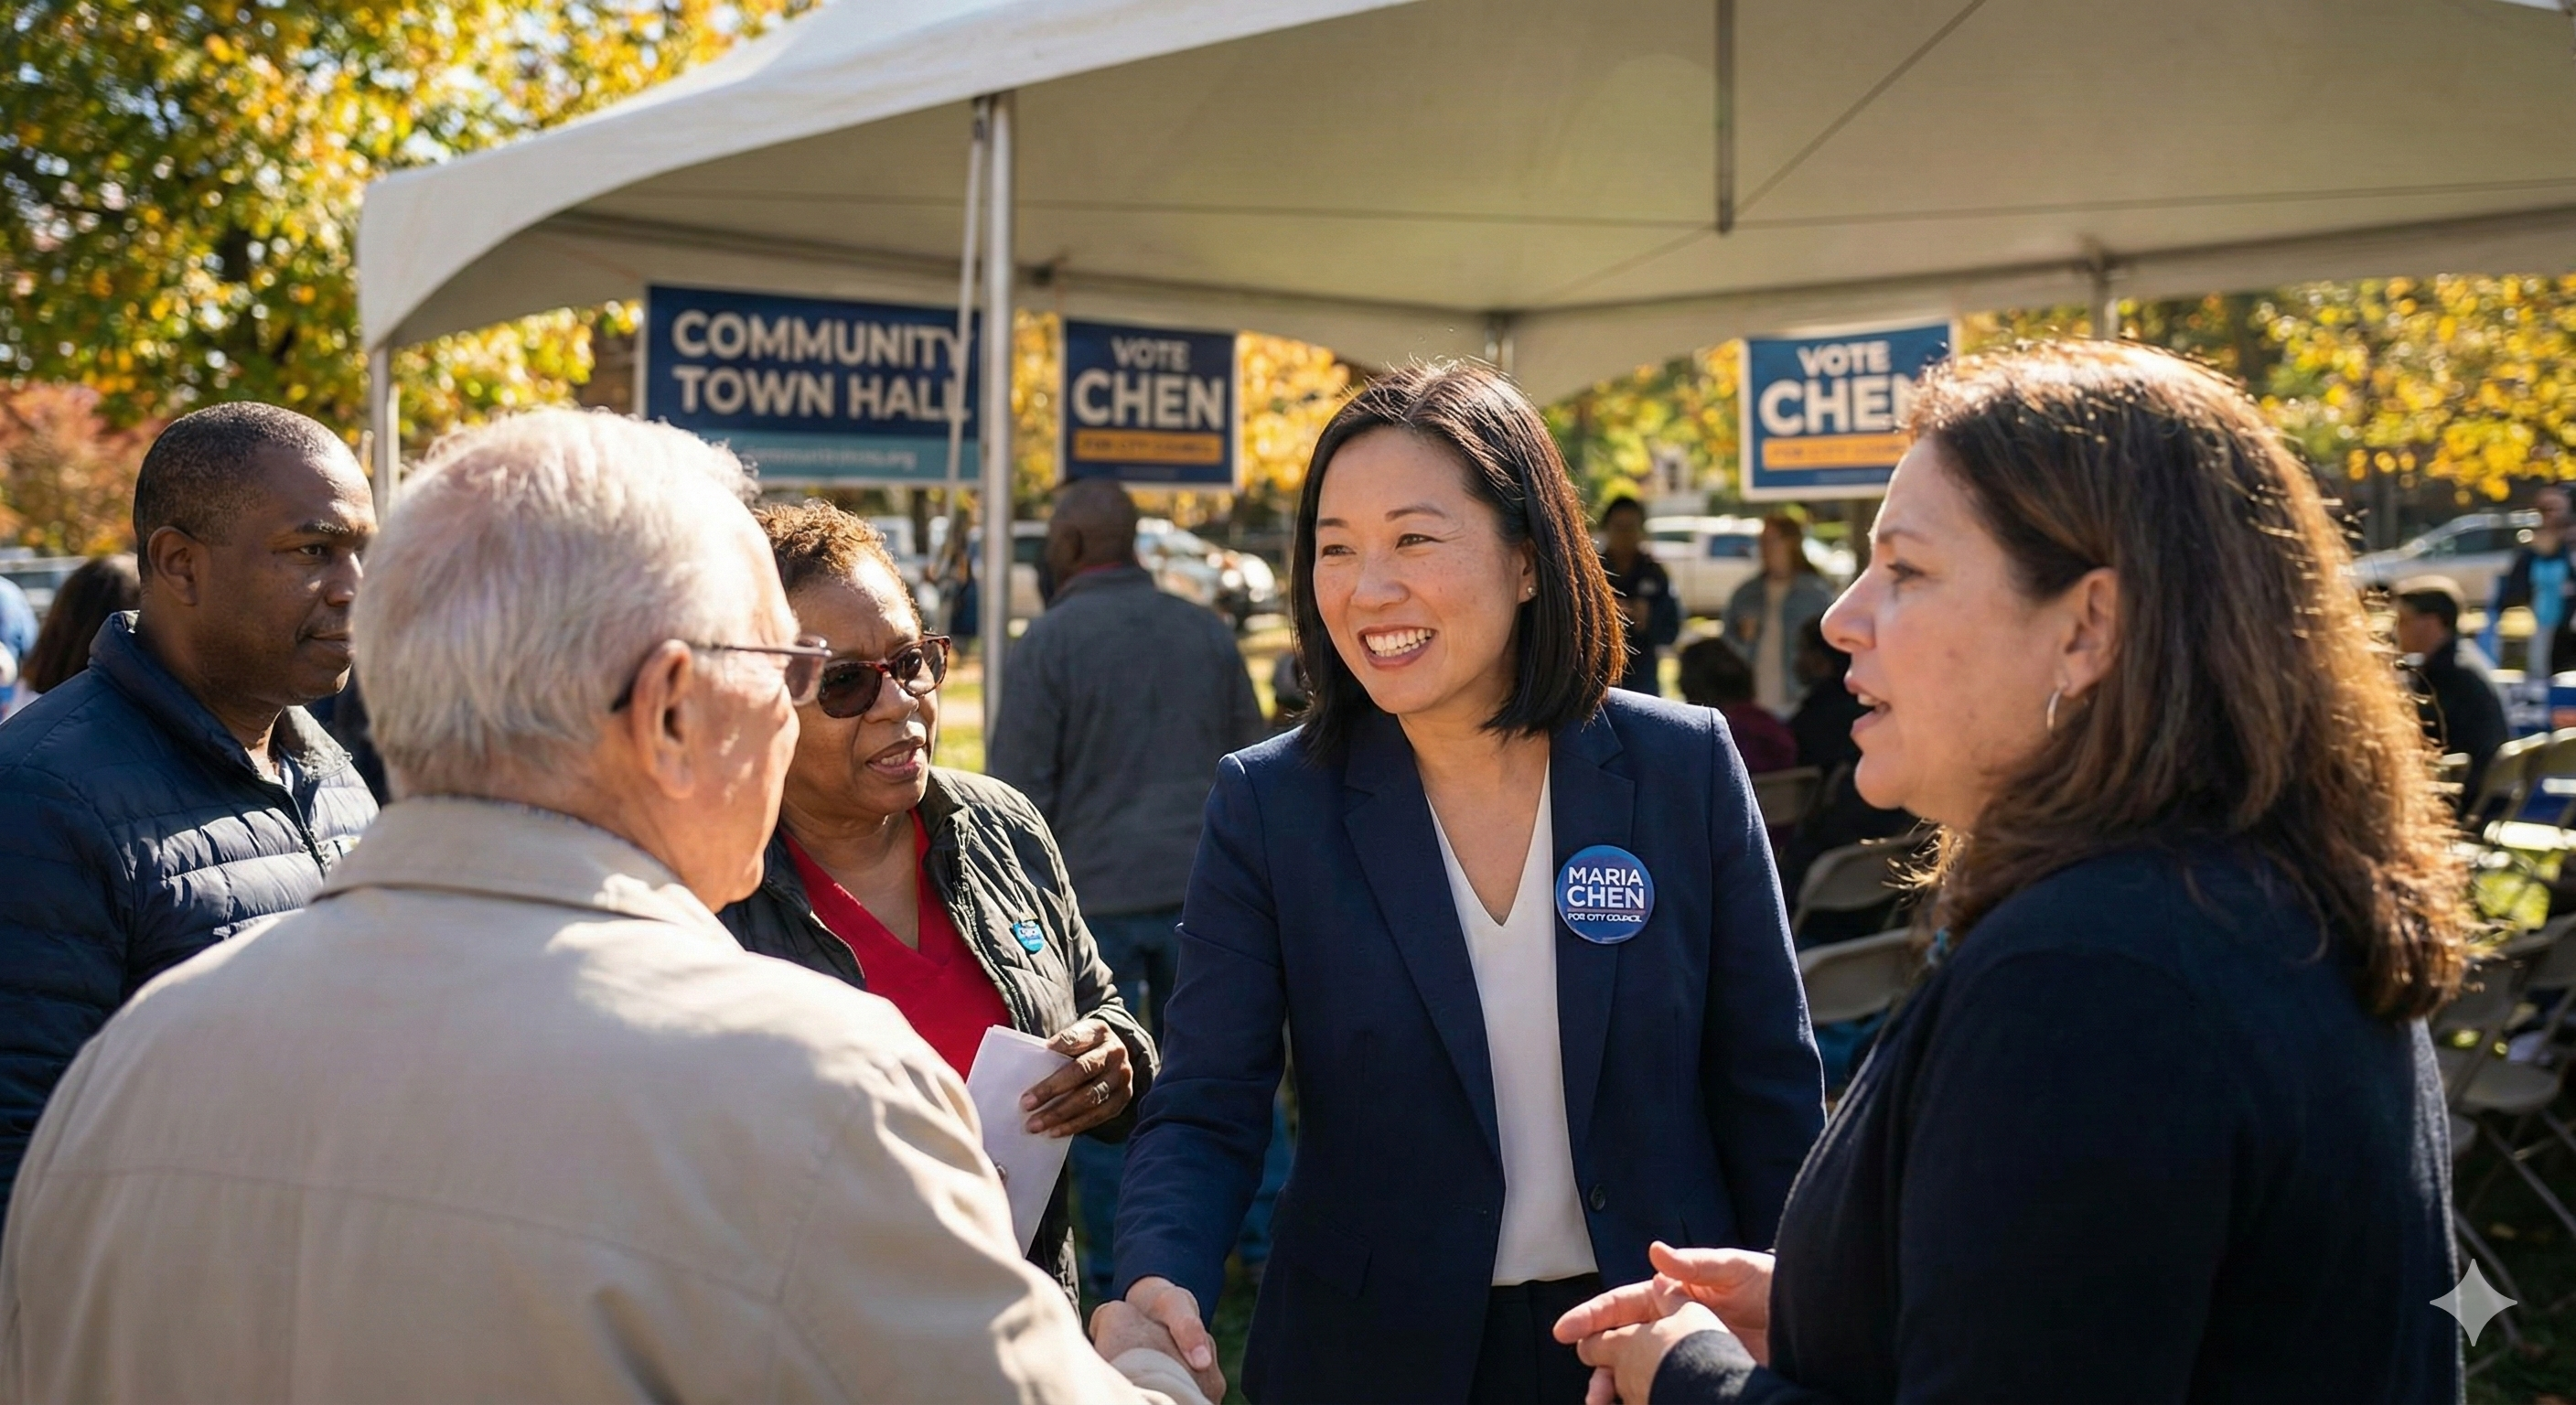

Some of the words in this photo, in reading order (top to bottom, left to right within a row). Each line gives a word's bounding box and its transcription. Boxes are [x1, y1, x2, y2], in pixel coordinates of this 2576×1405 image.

[1111, 336, 1190, 370] VOTE
[1797, 340, 1891, 377] VOTE
[671, 365, 835, 418] TOWN
[846, 371, 971, 422] HALL
[1071, 368, 1225, 431] CHEN
[1568, 866, 1644, 886] MARIA
[1566, 885, 1645, 909] CHEN
